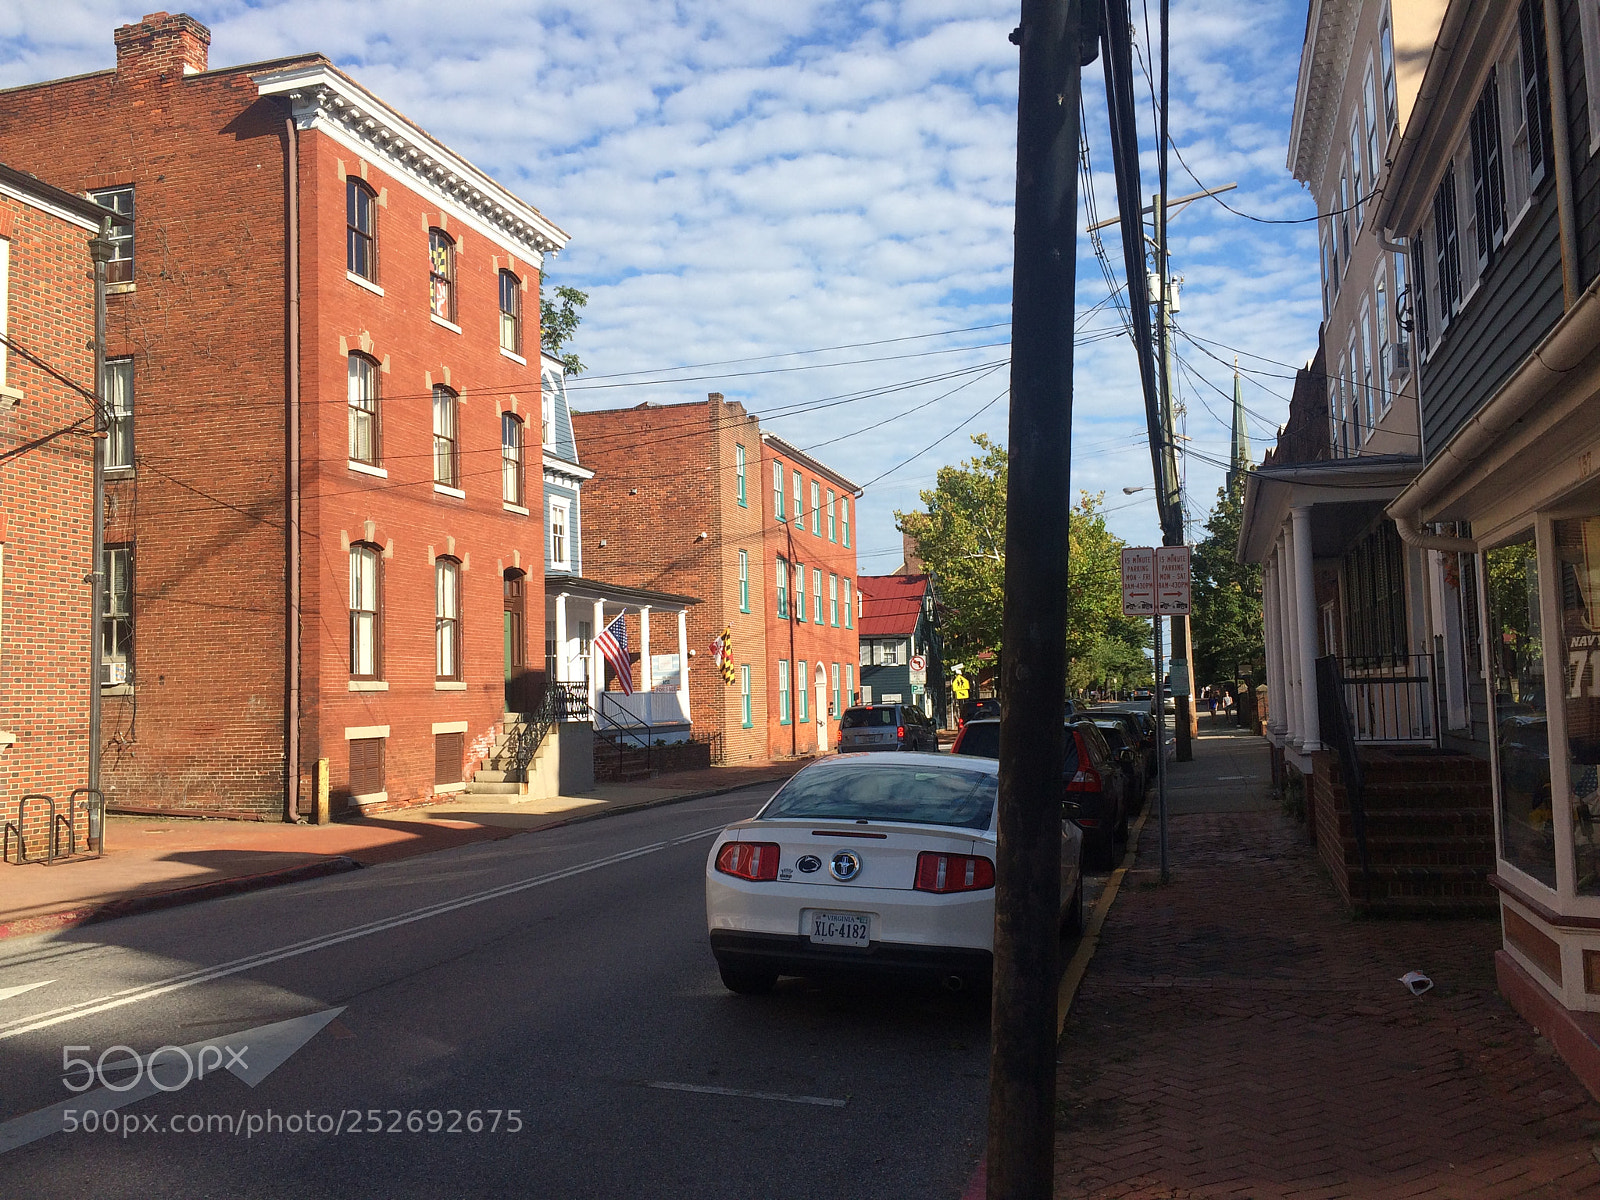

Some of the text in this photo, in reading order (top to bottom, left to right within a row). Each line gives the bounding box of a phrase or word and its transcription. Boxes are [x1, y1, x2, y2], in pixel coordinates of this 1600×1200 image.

[1132, 556, 1151, 564] MINUTE
[1166, 555, 1186, 563] MINUTE
[1161, 564, 1184, 572] PARKING
[1176, 572, 1186, 580] SAT
[814, 921, 866, 939] XLG-4182
